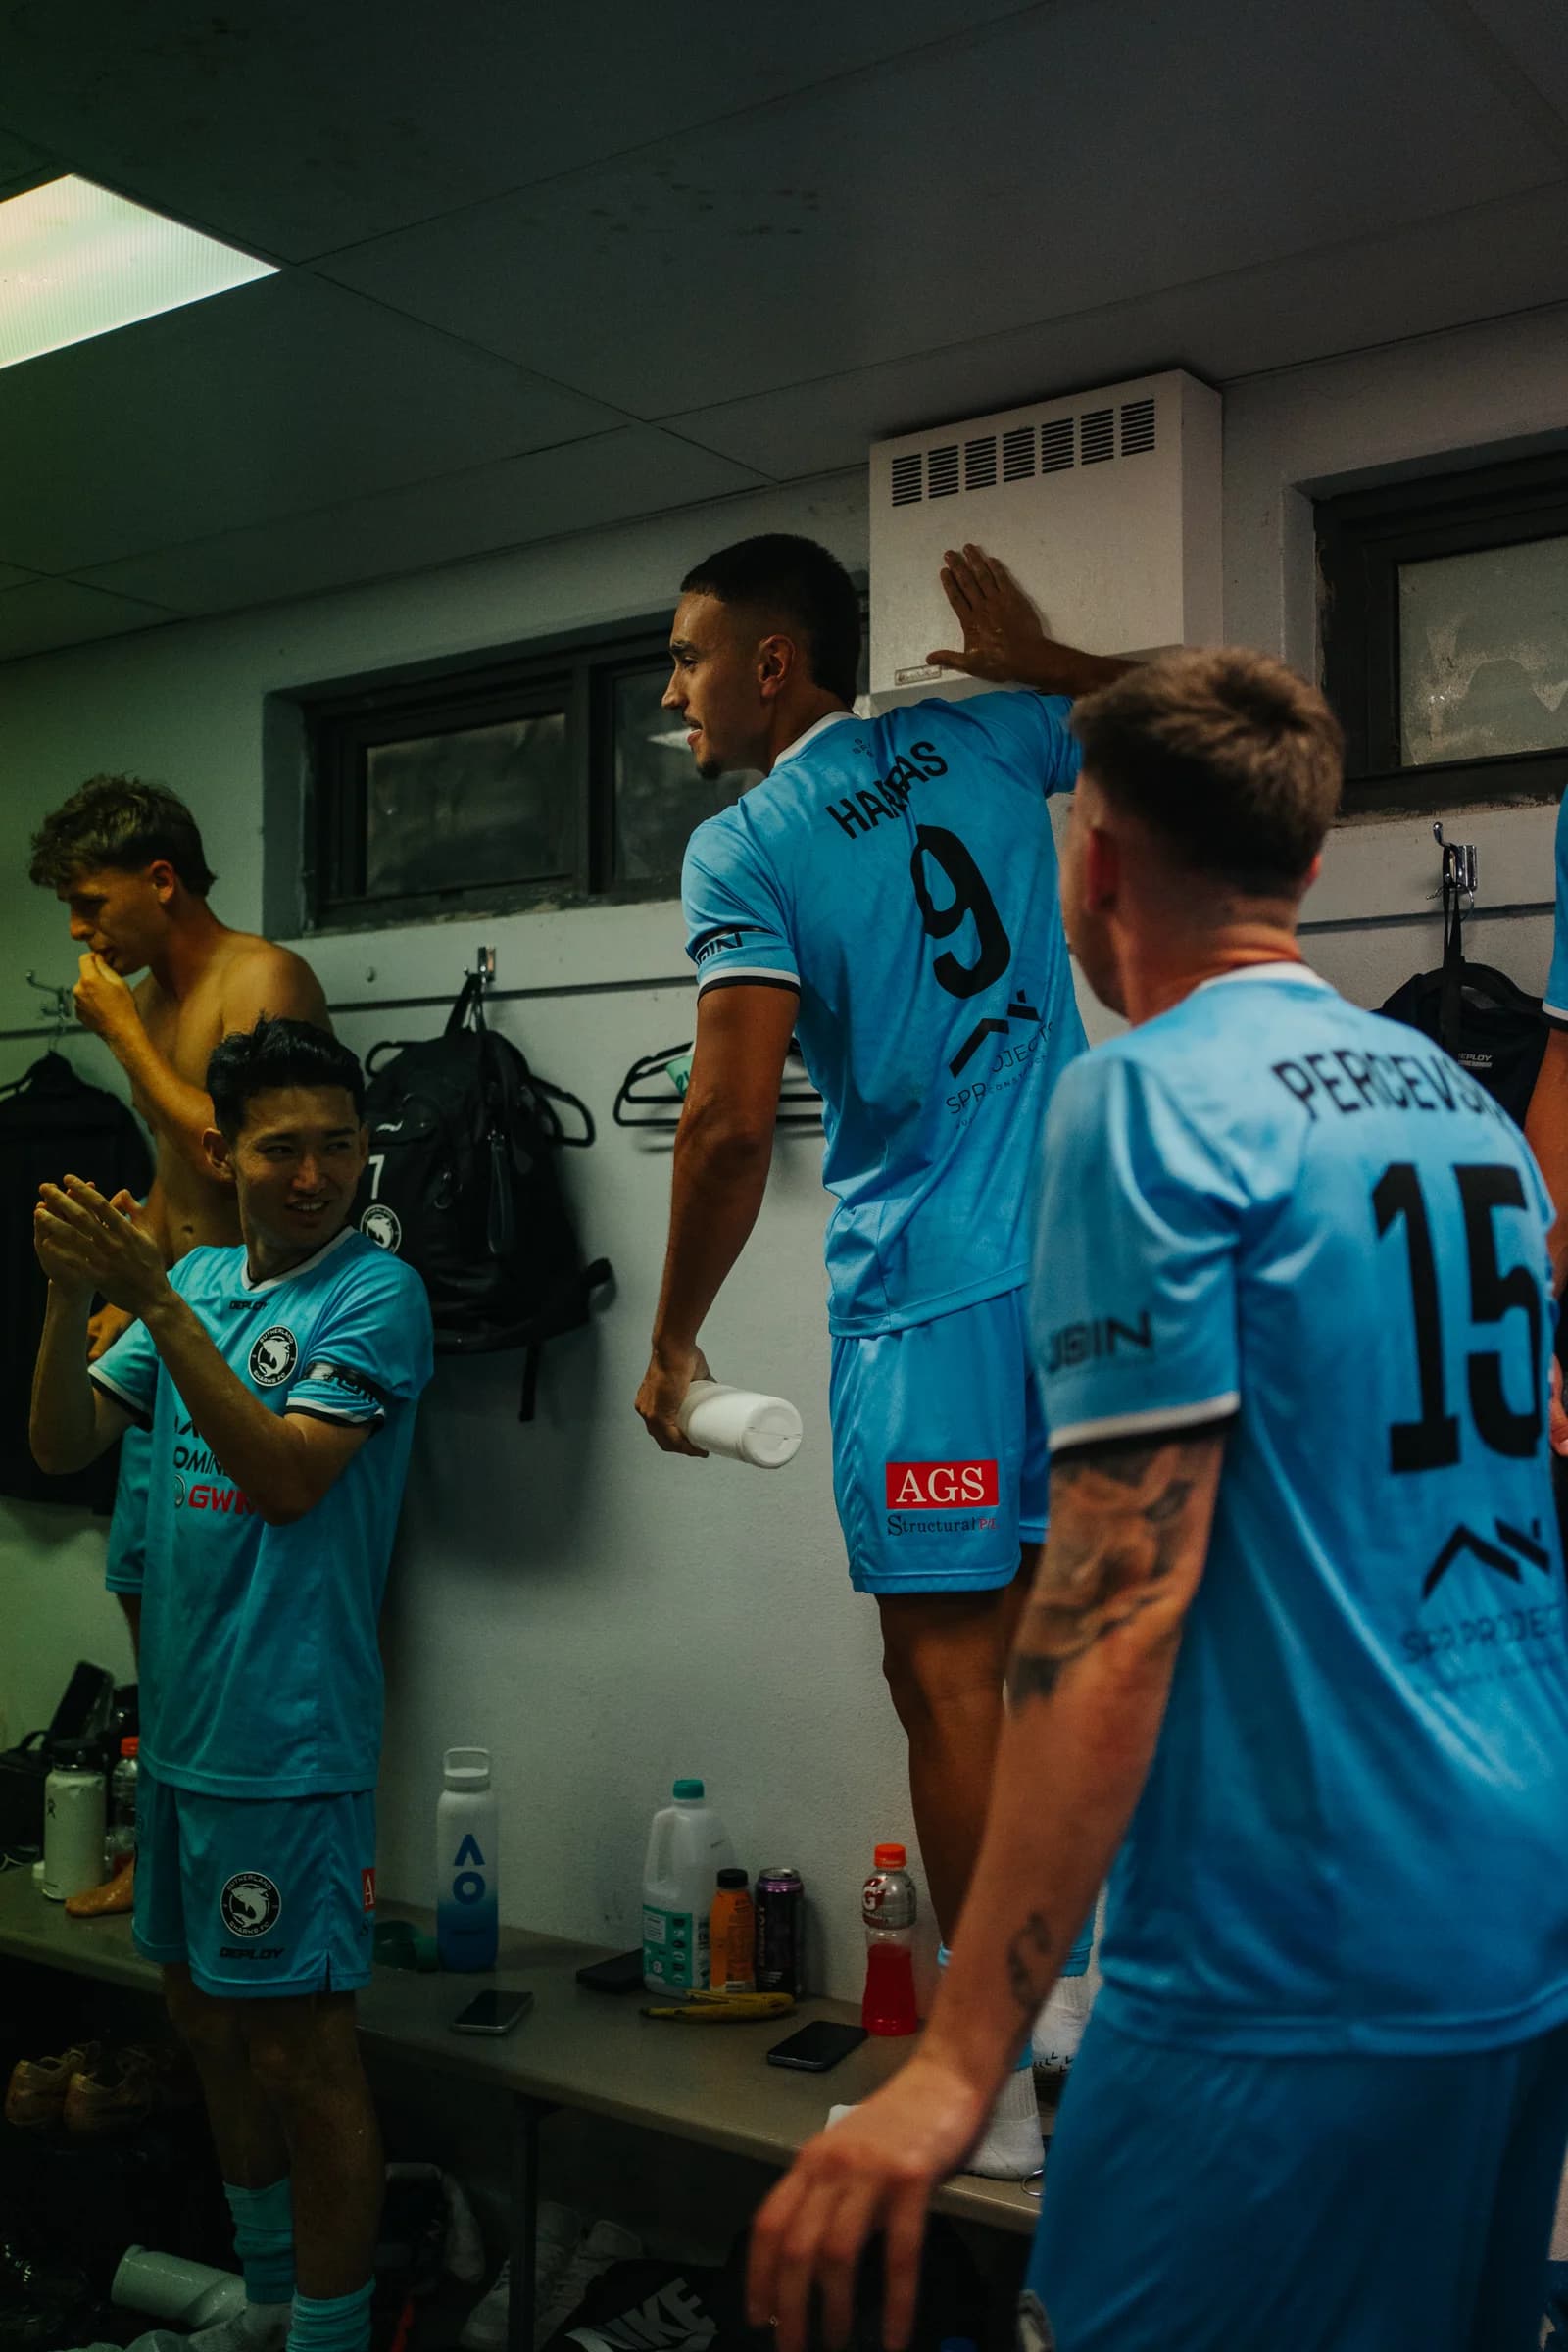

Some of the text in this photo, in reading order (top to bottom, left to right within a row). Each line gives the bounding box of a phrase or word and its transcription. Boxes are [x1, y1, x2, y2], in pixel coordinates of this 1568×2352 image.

[909, 824, 1010, 999] 9
[1458, 1053, 1492, 1061] EPLOY
[1372, 1161, 1541, 1475] 15
[895, 1467, 985, 1503] AGS
[888, 1515, 976, 1536] Structural
[226, 1874, 272, 1891] SUTHERLAND
[228, 1921, 259, 1935] SHARKS
